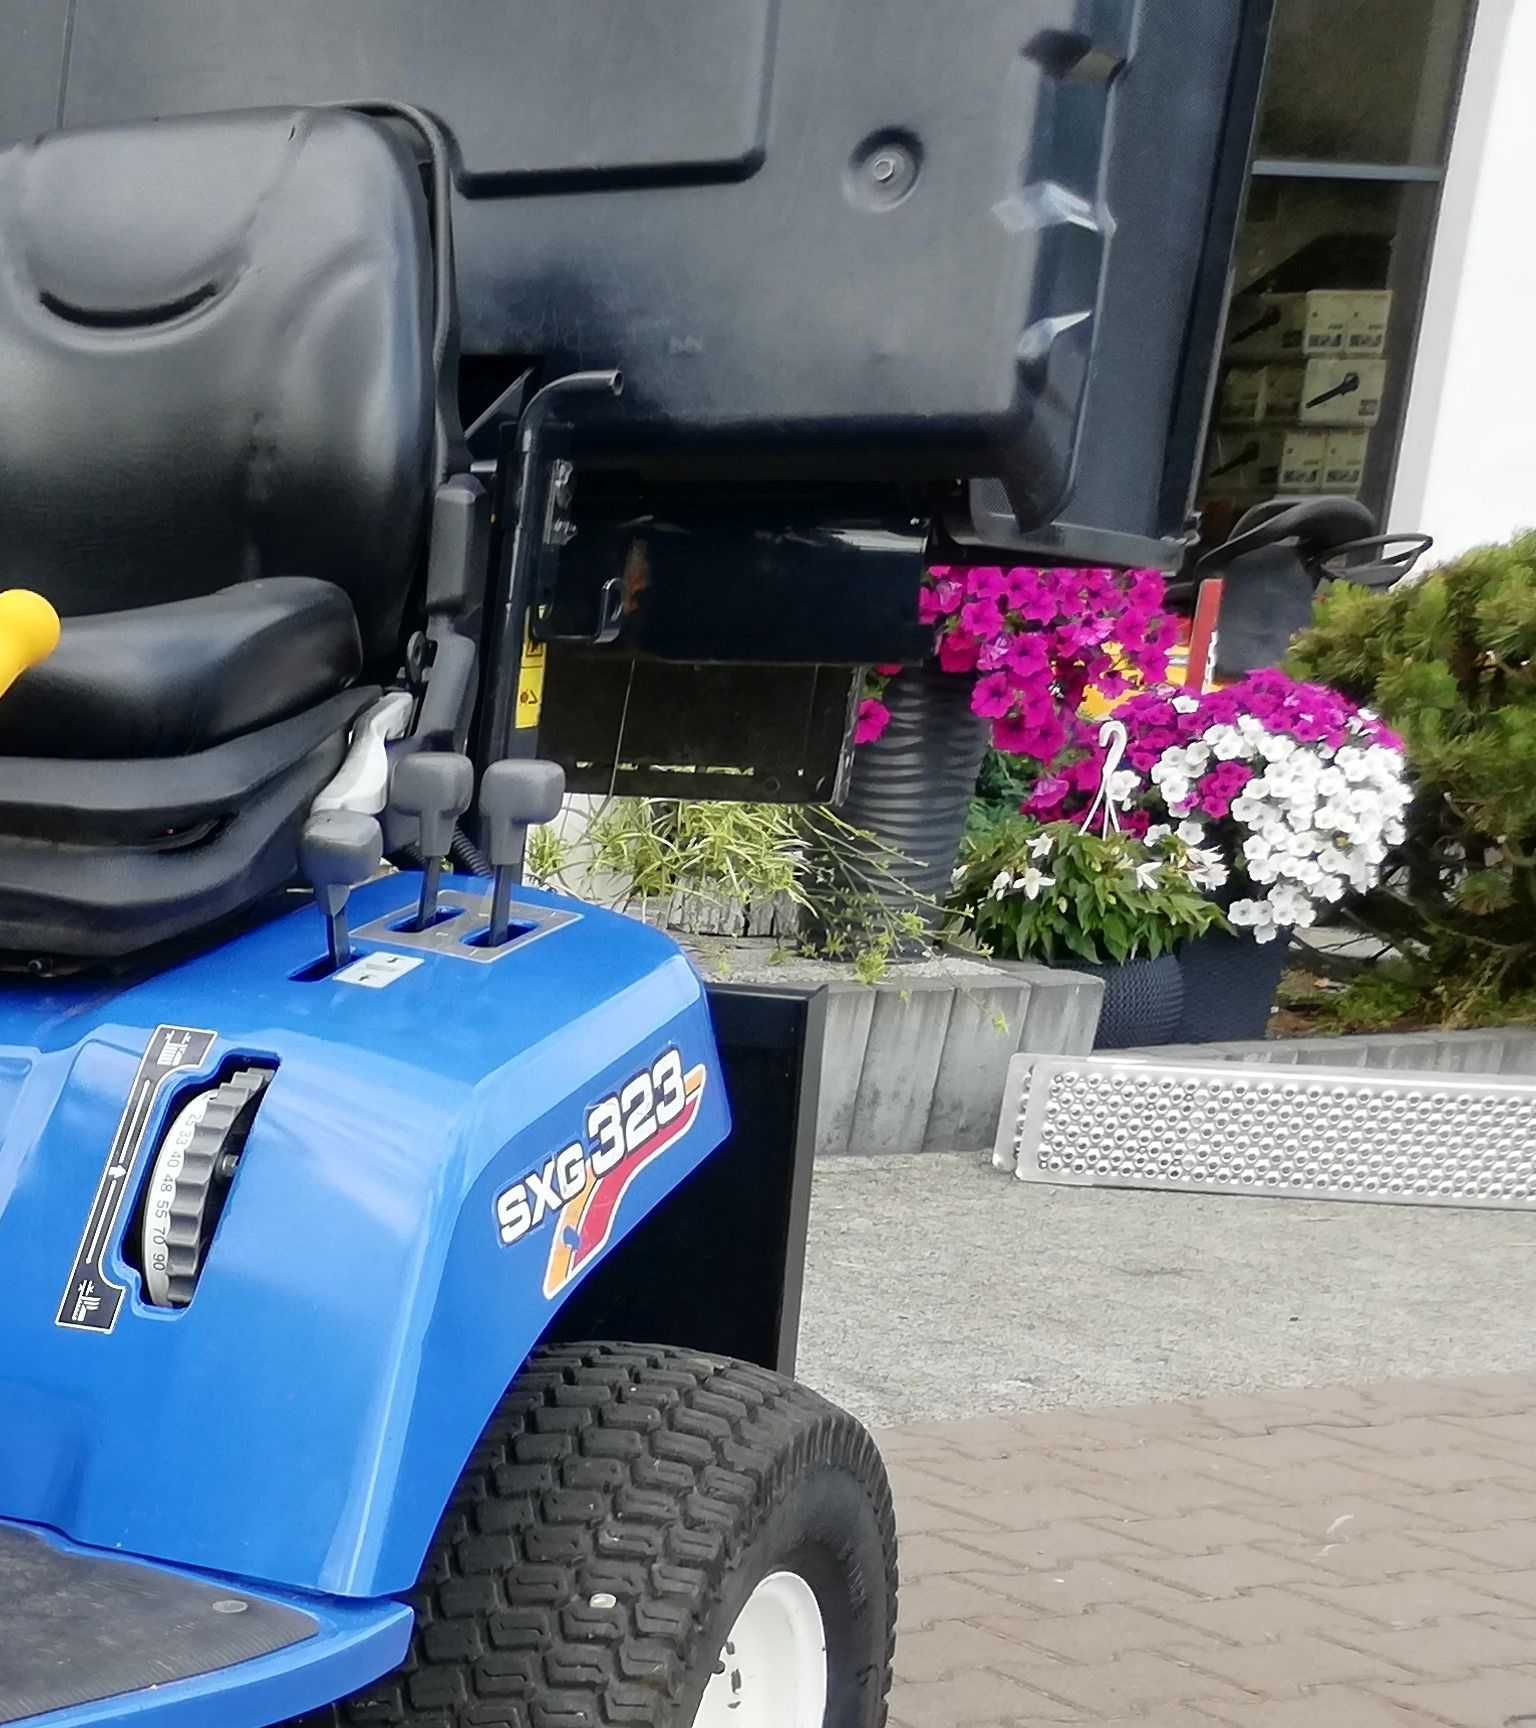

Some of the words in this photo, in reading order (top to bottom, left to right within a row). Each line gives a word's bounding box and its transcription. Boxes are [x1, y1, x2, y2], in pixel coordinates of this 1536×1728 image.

[160, 1173, 173, 1192] 48
[155, 1199, 169, 1218] 55
[152, 1226, 166, 1245] 70
[152, 1252, 166, 1271] 90
